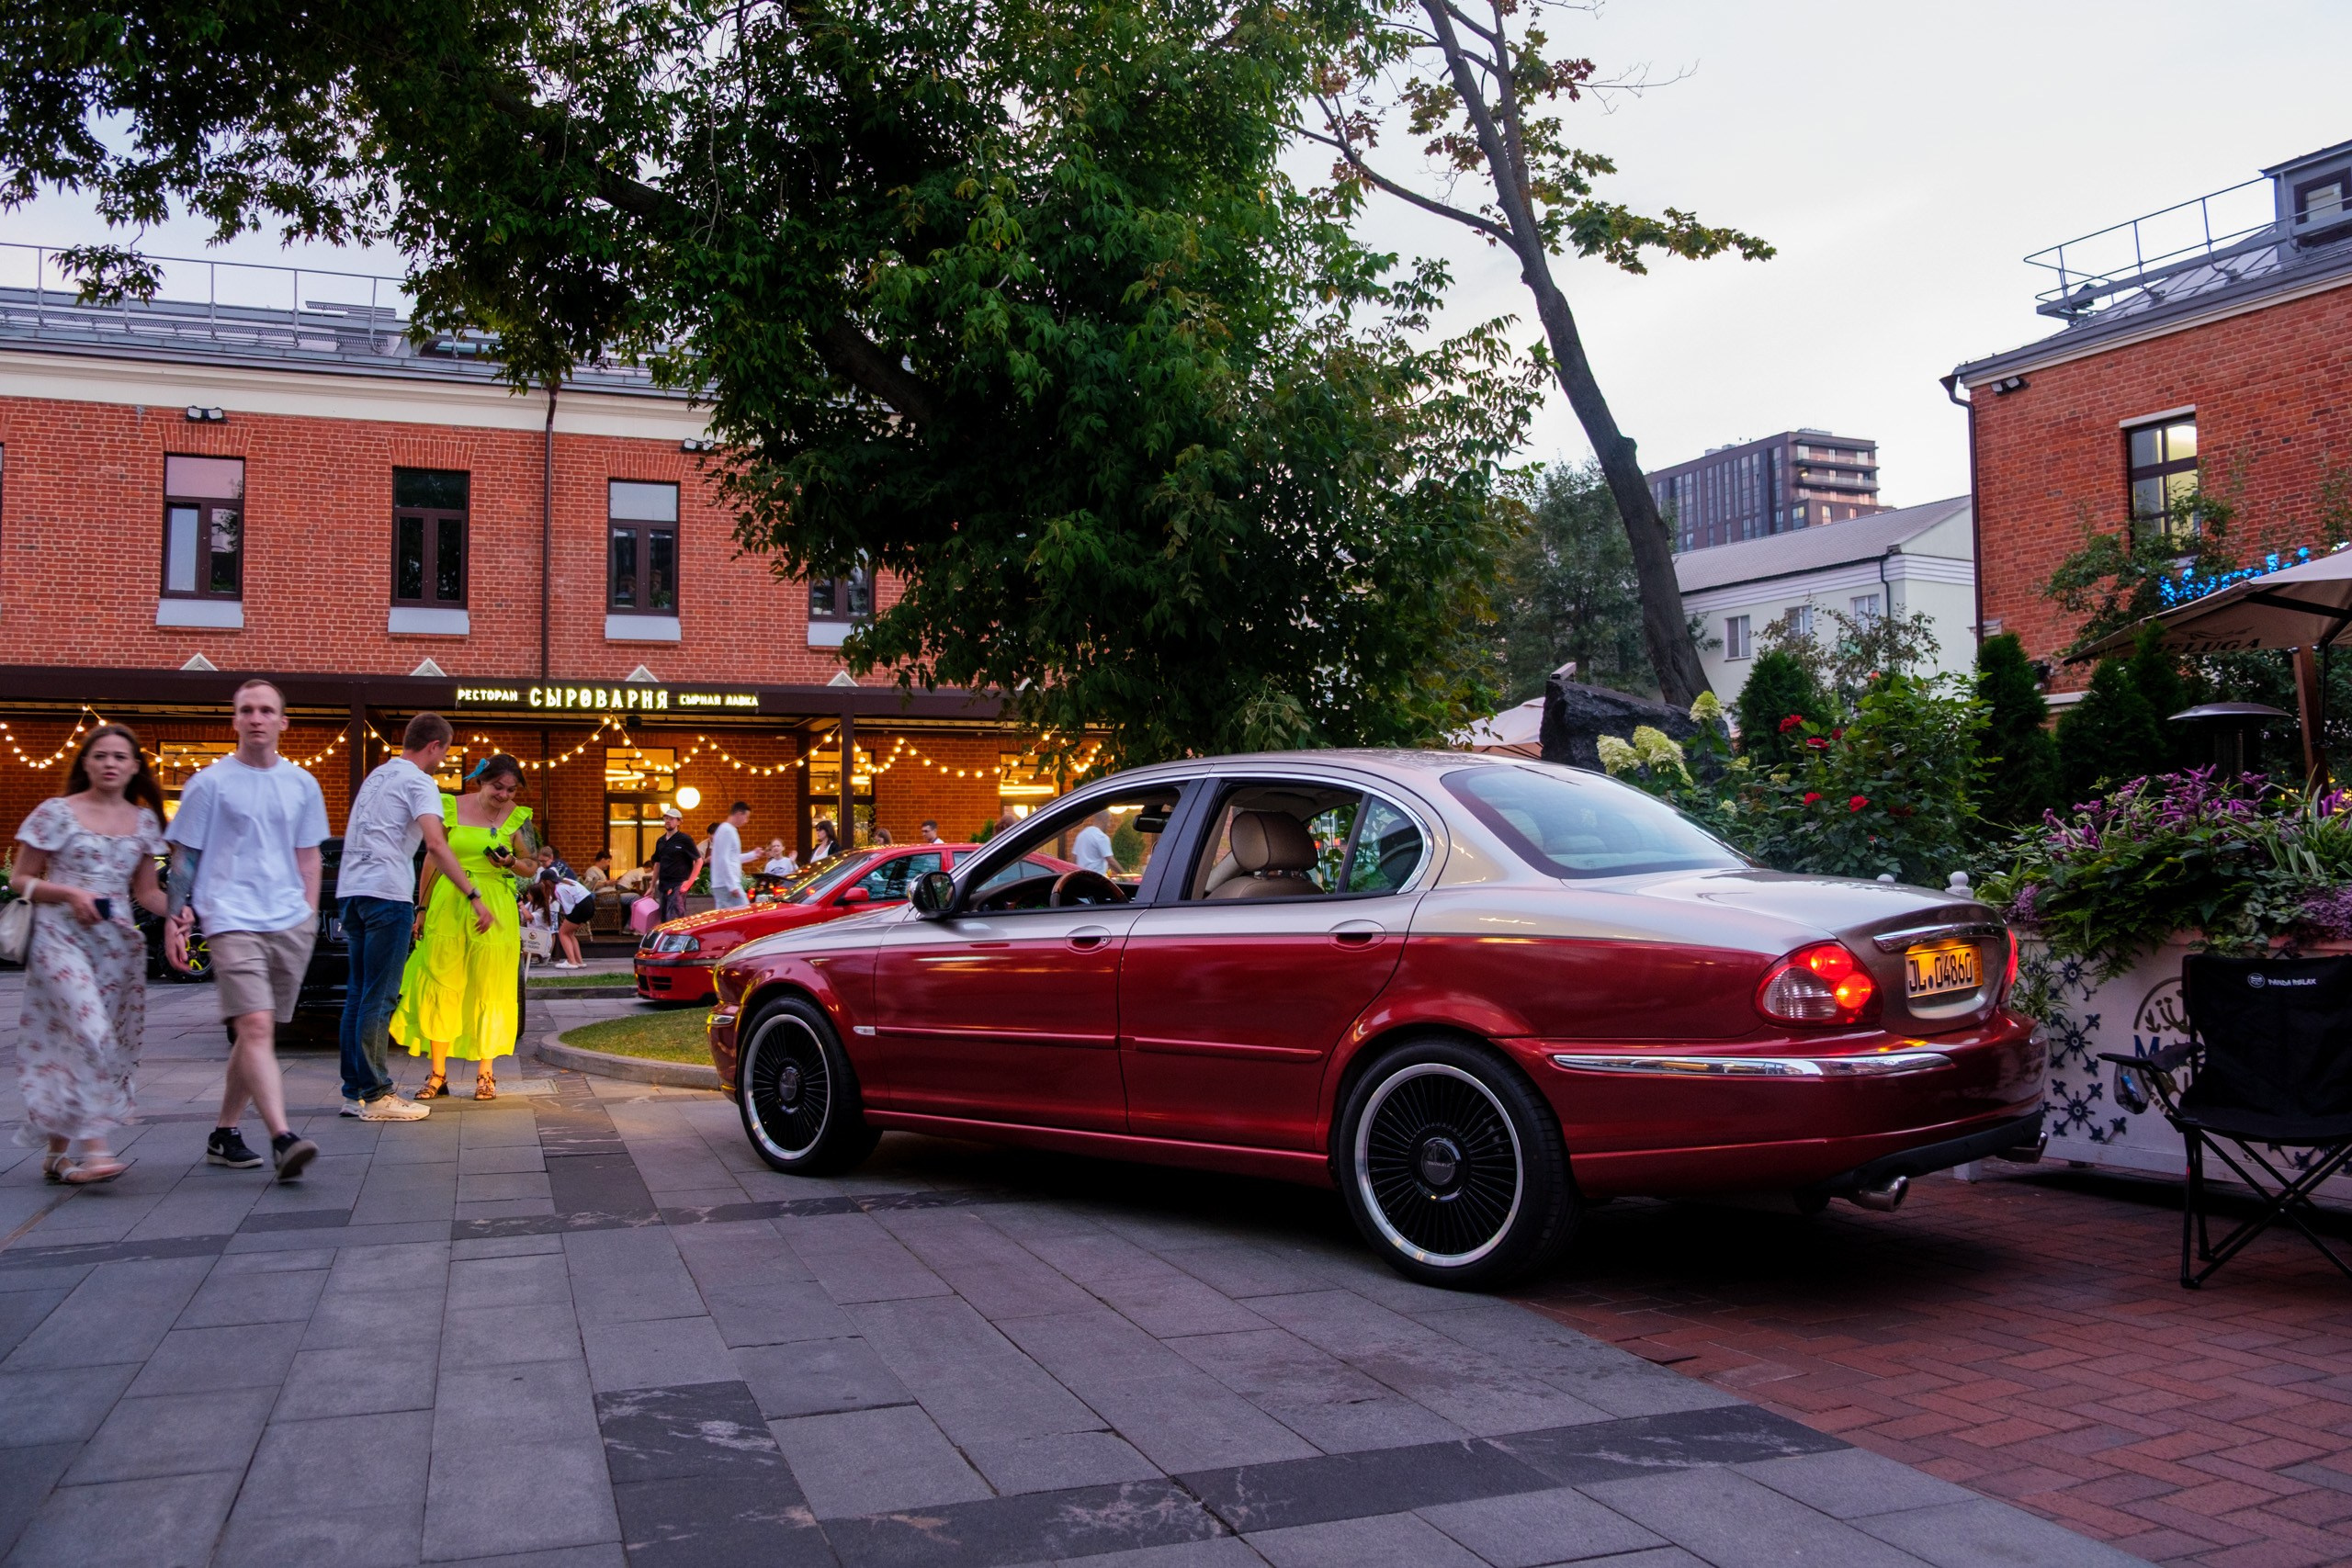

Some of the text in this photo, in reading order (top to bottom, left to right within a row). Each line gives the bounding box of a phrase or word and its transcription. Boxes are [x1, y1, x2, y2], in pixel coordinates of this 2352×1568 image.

[458, 689, 518, 701] РЕСТОРАН
[529, 687, 669, 708] СЫРОВАРНЯ
[679, 694, 721, 705] СЫРНАЯ
